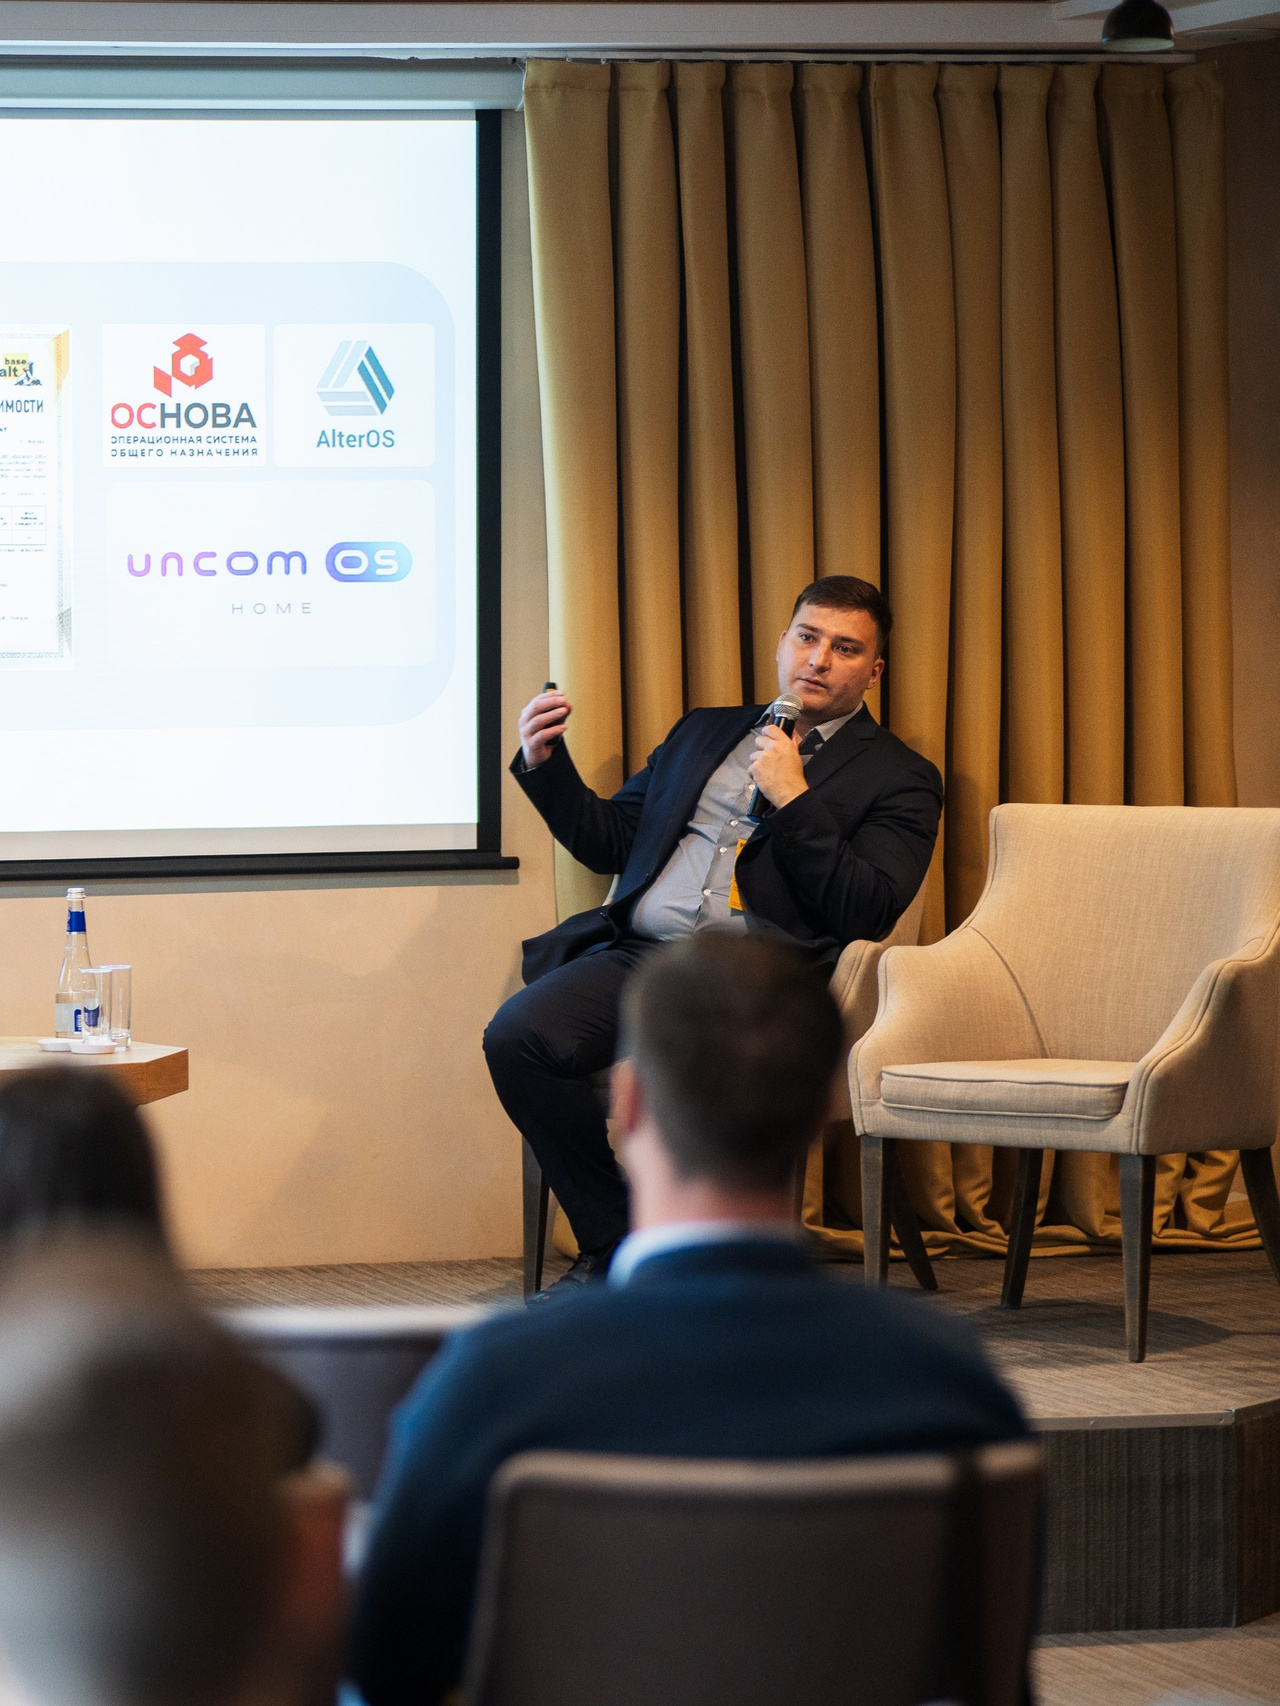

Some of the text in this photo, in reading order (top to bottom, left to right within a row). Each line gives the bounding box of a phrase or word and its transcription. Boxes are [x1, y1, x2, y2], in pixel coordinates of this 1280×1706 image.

[111, 402, 257, 429] ОСНОВА
[111, 436, 257, 444] ОПЕРАЦИОННАЯ СИСТЕМА
[316, 429, 395, 448] AlterOS
[111, 448, 258, 458] ОБЩЕГО НАЗНАЧЕНИЯ
[333, 549, 399, 576] OS
[231, 602, 311, 614] HOME
